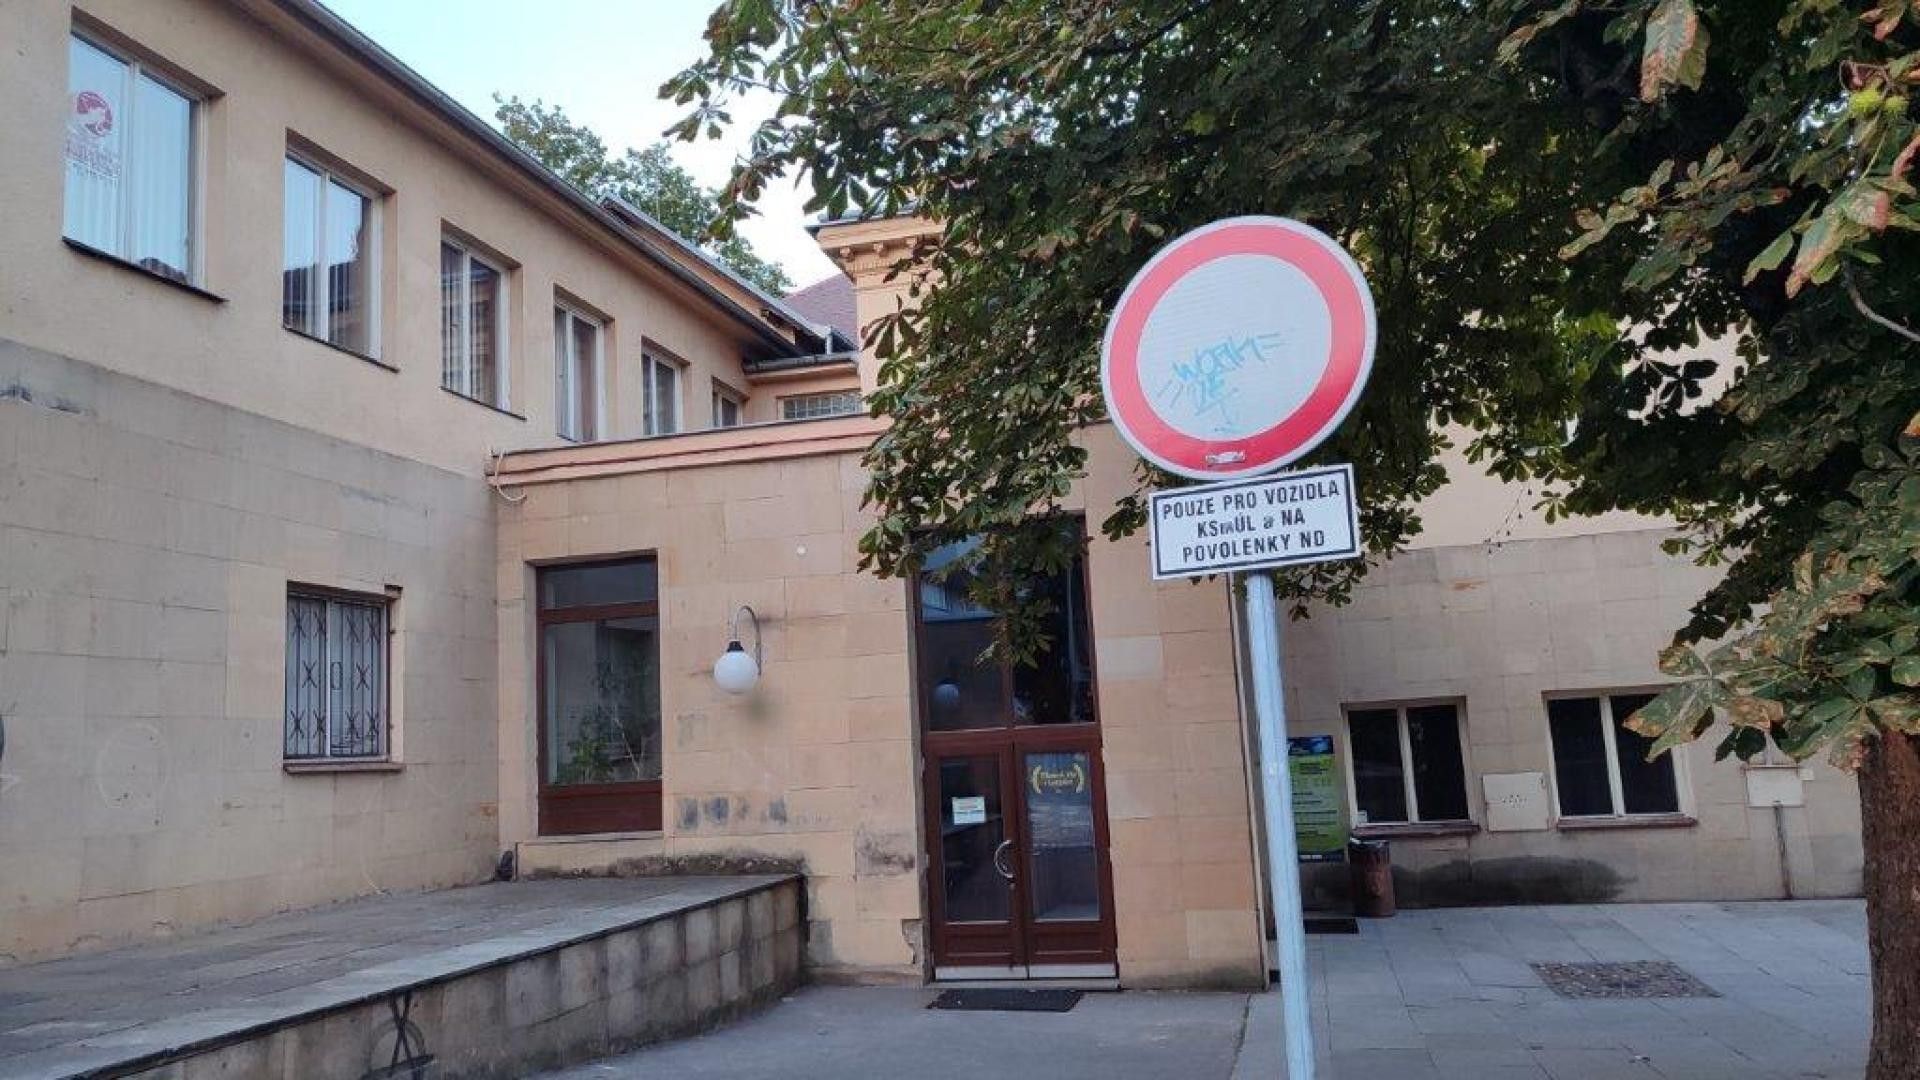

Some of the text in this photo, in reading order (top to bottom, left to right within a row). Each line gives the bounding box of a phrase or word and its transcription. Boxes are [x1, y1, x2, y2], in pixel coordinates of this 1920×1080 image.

[1162, 479, 1340, 520] POUZE PRO VOZIDLA
[1281, 507, 1306, 526] NA
[1183, 534, 1291, 563] POVOLENKY
